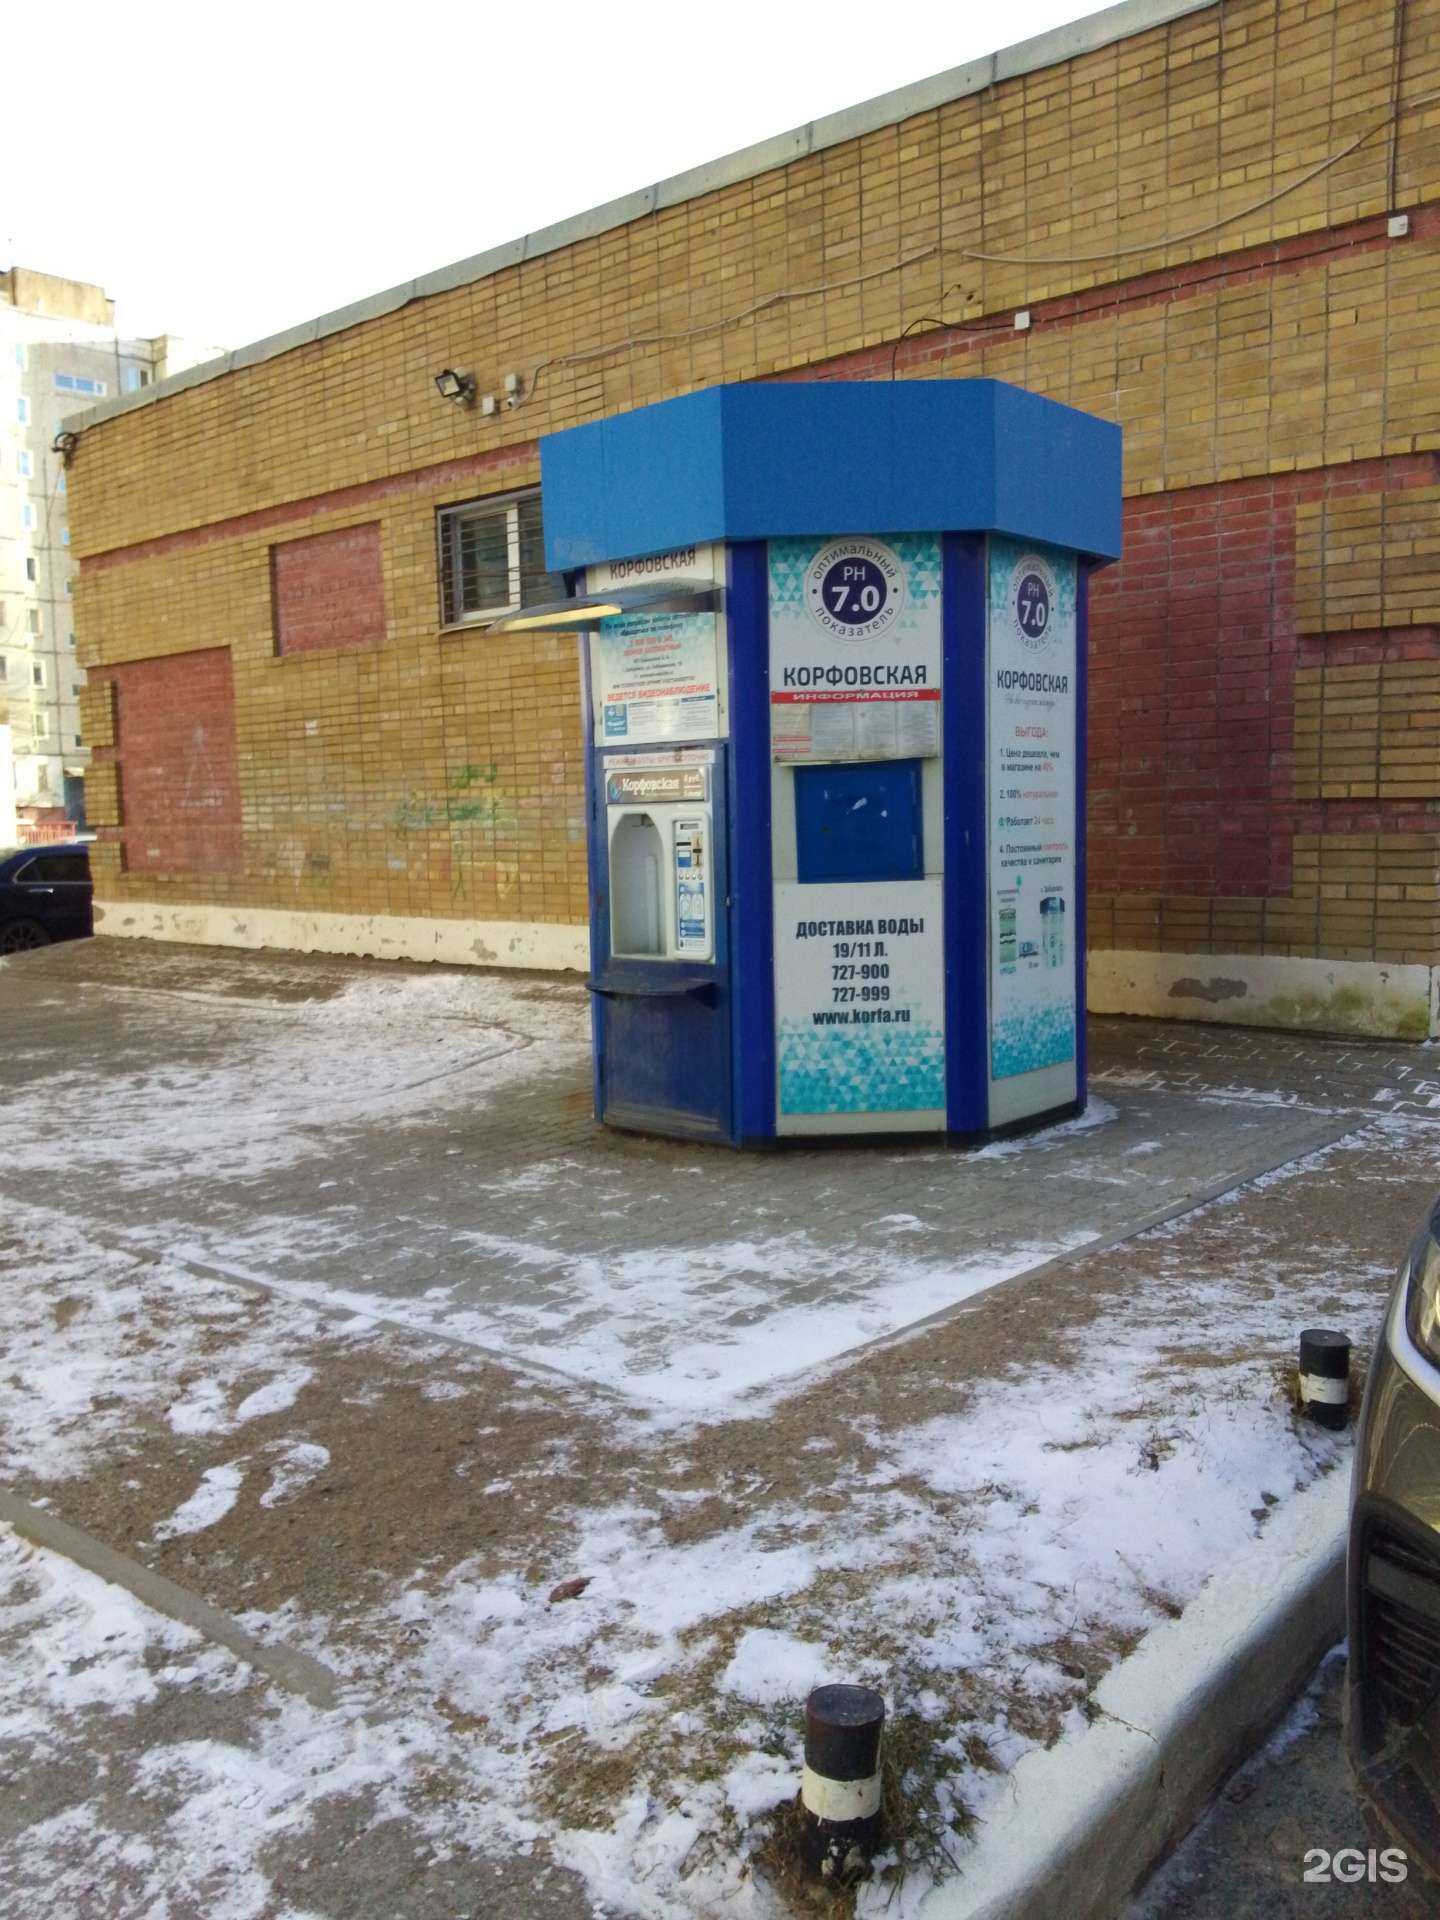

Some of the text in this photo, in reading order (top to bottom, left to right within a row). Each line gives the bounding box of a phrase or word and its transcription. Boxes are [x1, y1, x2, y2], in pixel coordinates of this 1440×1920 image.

[610, 549, 696, 580] КОРФОВСКАЯ
[814, 544, 898, 580] оптимальный
[832, 585, 881, 612] 7.0
[815, 607, 895, 637] показатель
[1021, 600, 1046, 627] 7.0
[783, 665, 927, 687] КОРФОВСКАЯ
[997, 670, 1069, 693] КОРФОВСКАЯ
[792, 690, 919, 700] ИНФОРМАЦИЯ
[795, 918, 924, 939] ДОСТАВКА ВОДЫ
[833, 942, 871, 958] 19/11
[832, 964, 890, 980] 727-900
[832, 985, 890, 1002] 727-999
[813, 1008, 911, 1025] www.korfa.ru
